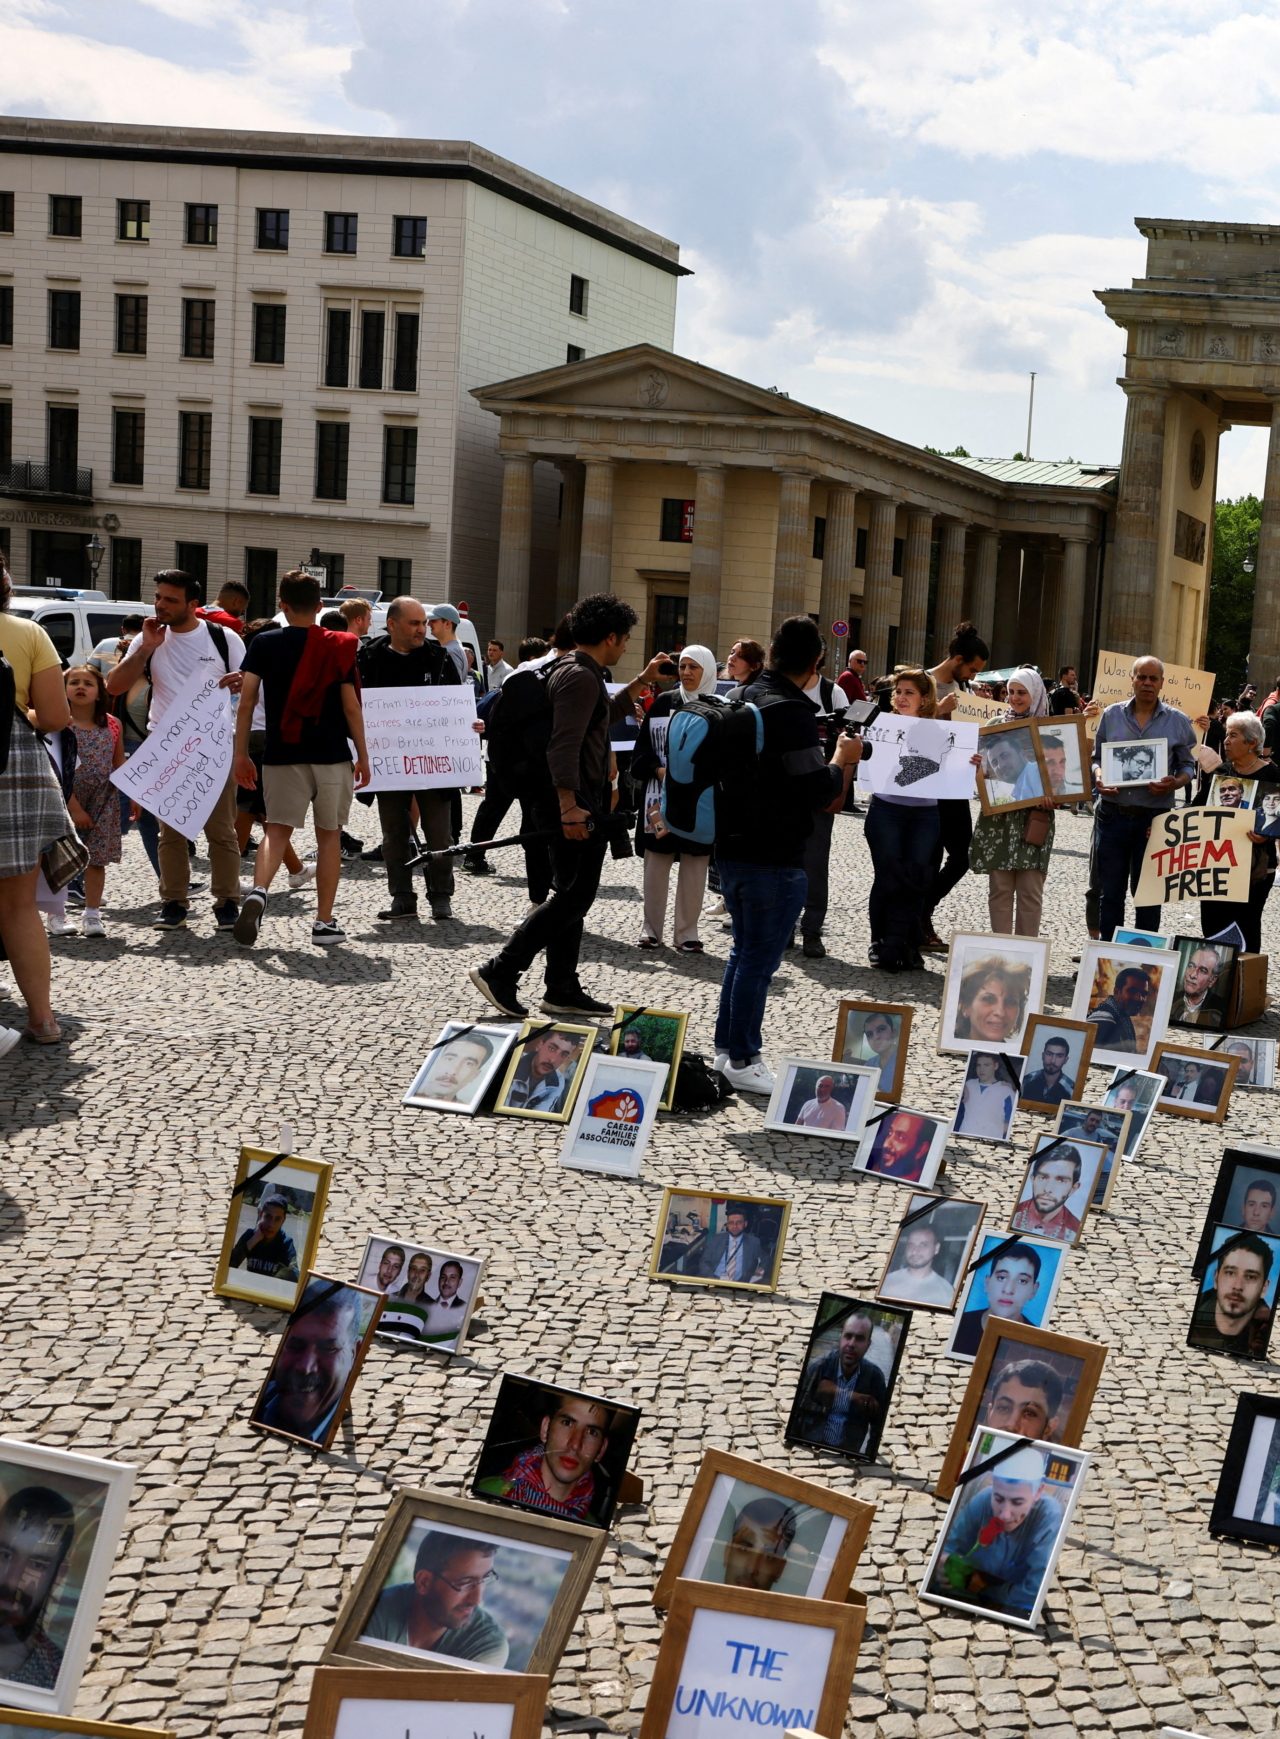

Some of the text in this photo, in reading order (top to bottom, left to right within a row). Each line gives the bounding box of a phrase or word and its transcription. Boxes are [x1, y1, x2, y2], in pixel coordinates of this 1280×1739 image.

[1103, 657, 1126, 677] Was
[124, 751, 159, 786] How
[160, 712, 200, 752] many
[190, 678, 219, 712] more
[210, 723, 227, 747] for
[366, 719, 401, 729] tainees
[140, 735, 202, 804] massacres
[208, 702, 225, 720] be
[366, 737, 391, 750] SAD
[372, 756, 401, 777] REE
[175, 772, 216, 825] world
[1164, 810, 1236, 847] SET
[1151, 839, 1238, 877] THEM
[1164, 867, 1230, 903] FREE
[579, 1132, 637, 1148] ASSOCIATION
[601, 1128, 638, 1140] FAMILIES
[606, 1121, 640, 1133] CAESAR
[726, 1640, 789, 1681] THE
[675, 1685, 814, 1729] UNKNOWN
